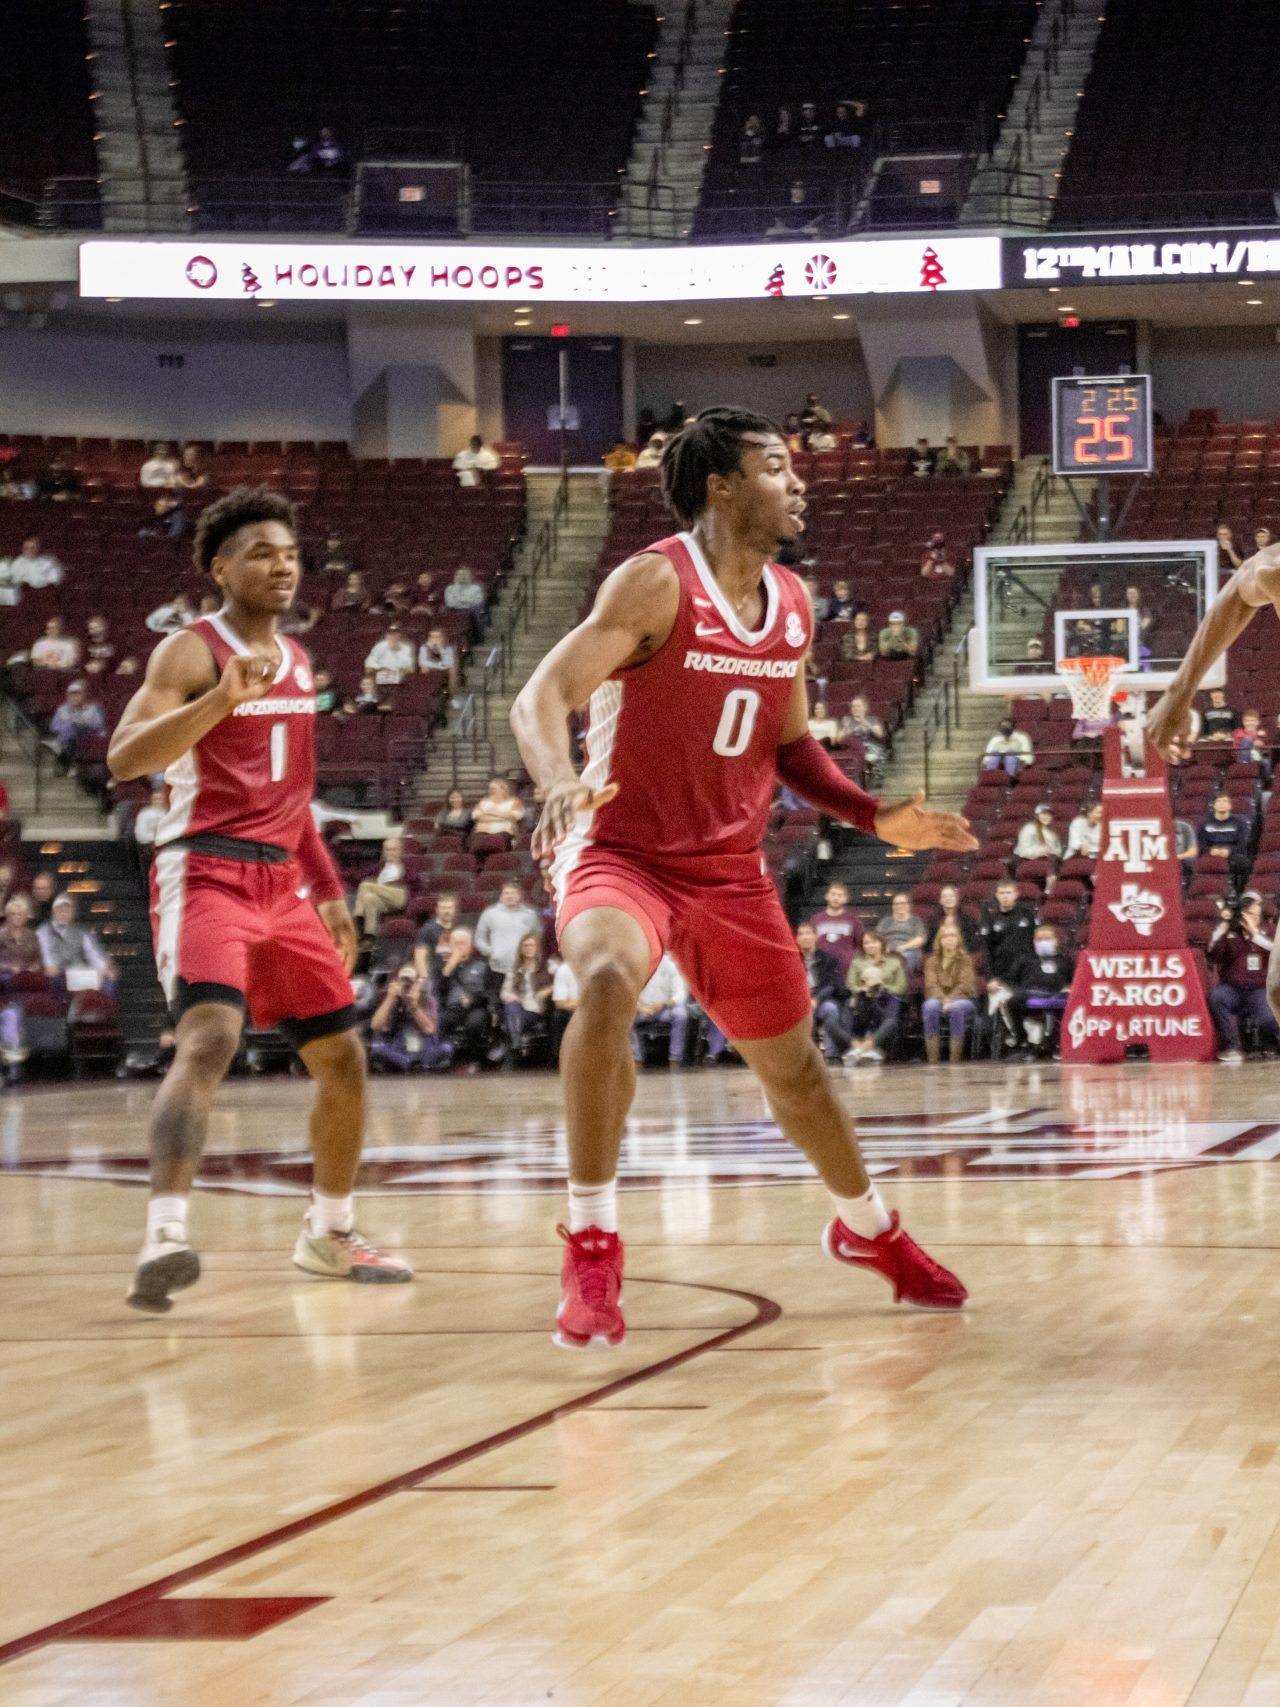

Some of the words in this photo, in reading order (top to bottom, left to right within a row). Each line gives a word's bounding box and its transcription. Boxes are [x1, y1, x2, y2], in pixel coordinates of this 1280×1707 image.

[275, 264, 417, 288] HOLIDAY
[431, 264, 545, 289] HOOPS
[1081, 389, 1098, 413] 2
[1106, 387, 1137, 411] 25
[1073, 414, 1134, 463] 25
[712, 687, 762, 758] 0
[271, 720, 288, 782] 1
[1088, 956, 1185, 979] WELLS
[1090, 984, 1187, 1007] FARGO
